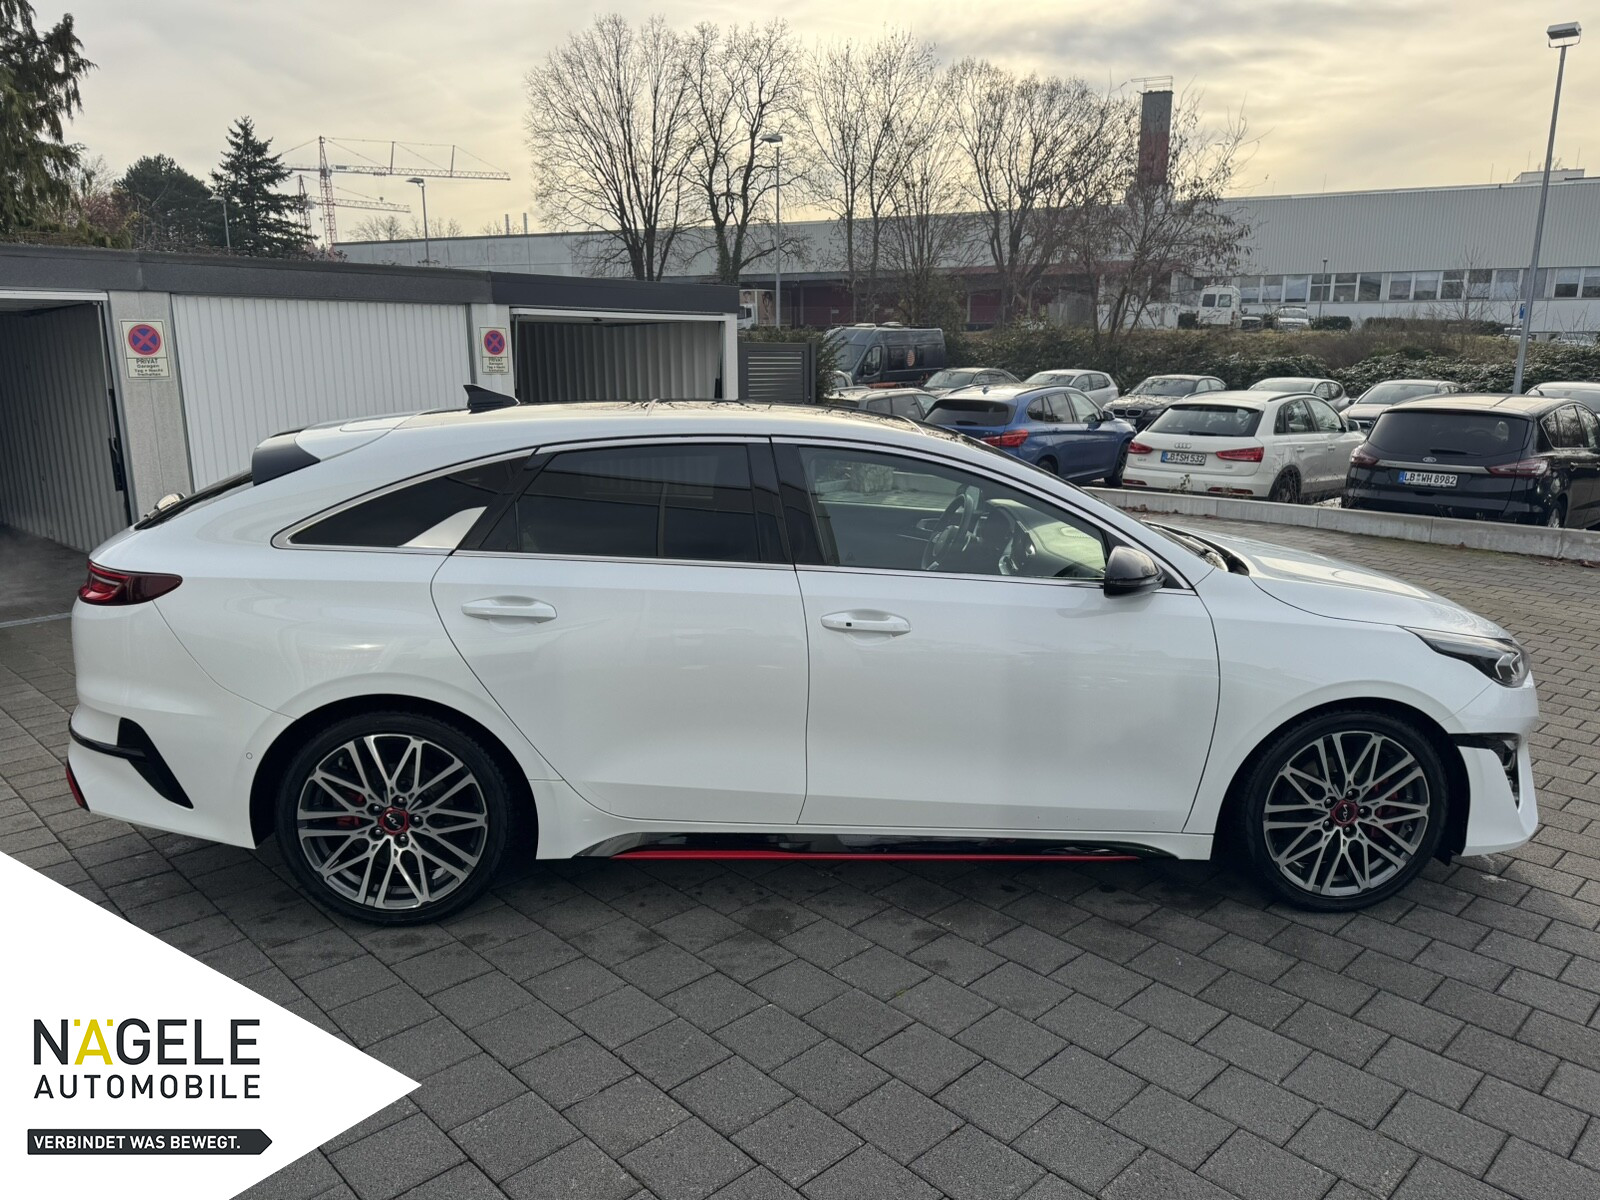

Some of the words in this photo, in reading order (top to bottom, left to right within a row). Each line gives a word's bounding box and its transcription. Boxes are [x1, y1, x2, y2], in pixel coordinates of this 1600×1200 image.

[1190, 454, 1206, 464] 532
[1404, 472, 1416, 482] LB
[1421, 473, 1433, 483] WH
[1433, 474, 1457, 486] 8982
